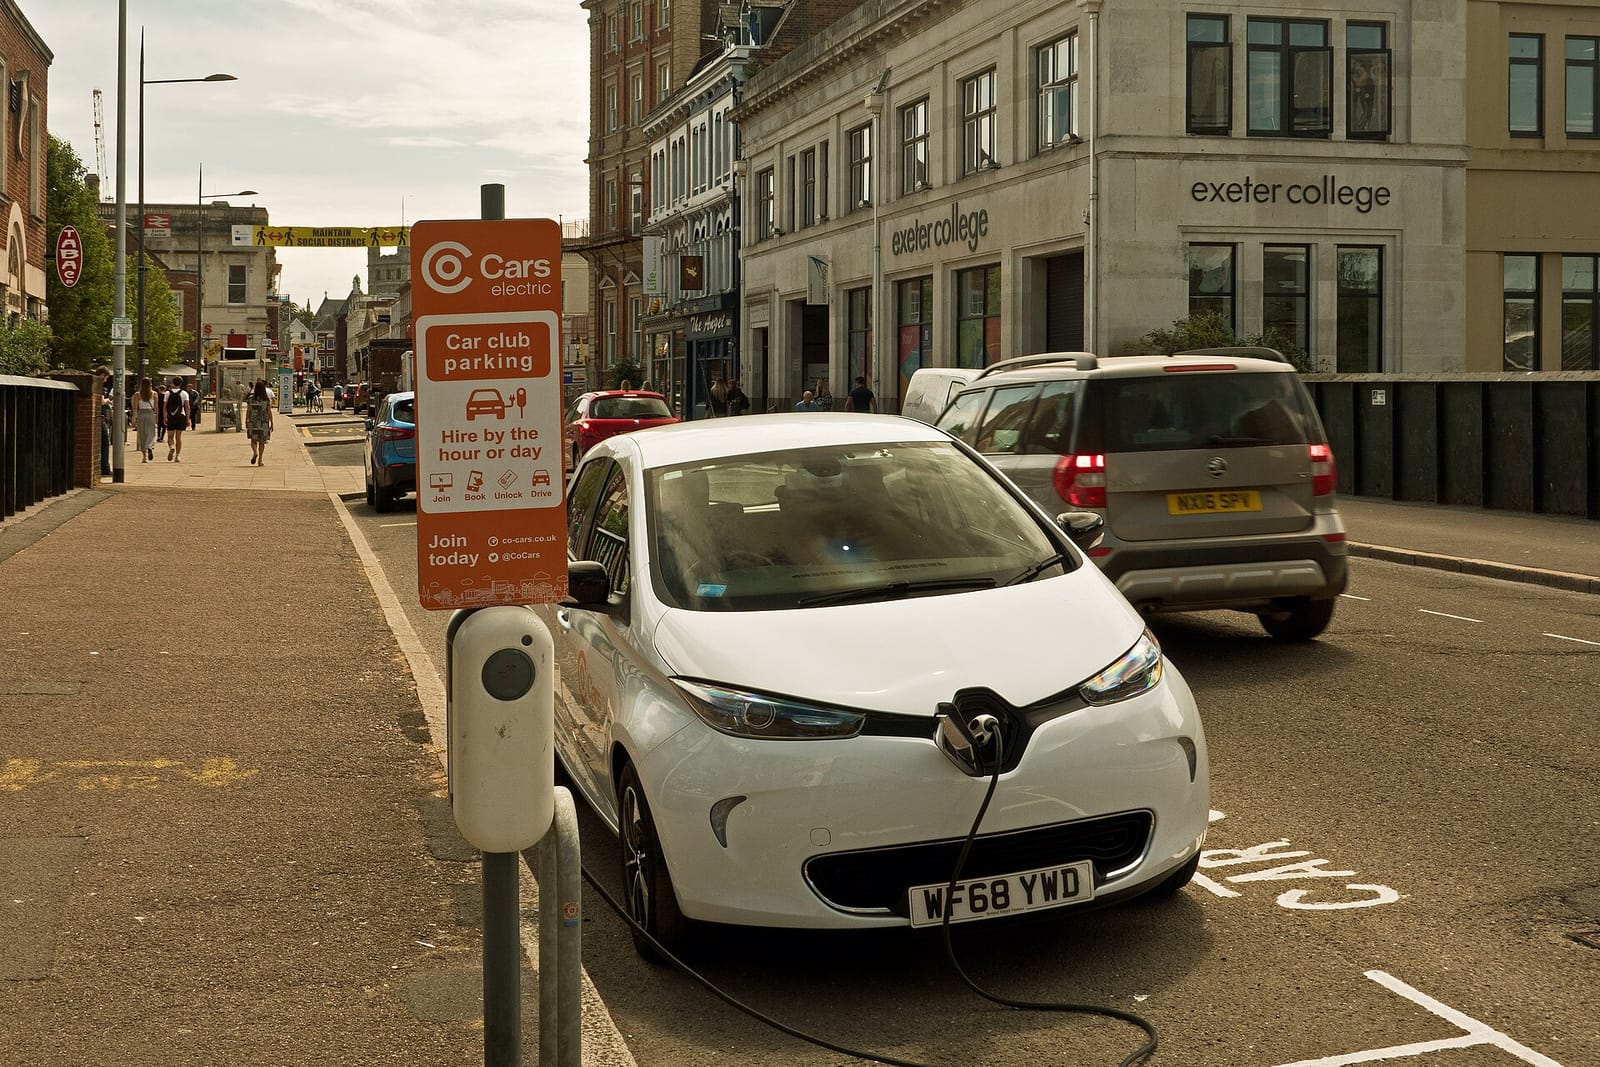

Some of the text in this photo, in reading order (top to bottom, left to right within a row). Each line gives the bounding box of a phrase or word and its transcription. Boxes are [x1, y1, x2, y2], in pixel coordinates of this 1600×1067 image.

[1191, 174, 1391, 213] exeter college
[312, 228, 351, 237] MAINTAIN
[892, 201, 989, 256] exeter college
[297, 238, 366, 246] SOCIAL DISTANCE
[480, 253, 551, 280] Cars
[491, 280, 551, 296] electric
[647, 272, 657, 291] Life
[690, 313, 726, 334] The Angel
[446, 331, 530, 350] Car club
[444, 352, 533, 375] parking
[441, 427, 539, 444] Hire by the
[439, 445, 542, 461] hour or day
[432, 495, 451, 503] Join
[464, 493, 486, 501] Book
[494, 491, 523, 500] Unlock
[531, 490, 552, 498] Drive
[428, 534, 467, 549] Join
[502, 534, 557, 544] co-cars.co.uk
[428, 551, 479, 567] today
[502, 552, 541, 562] @CoCars
[923, 867, 1079, 920] WF68 YWD
